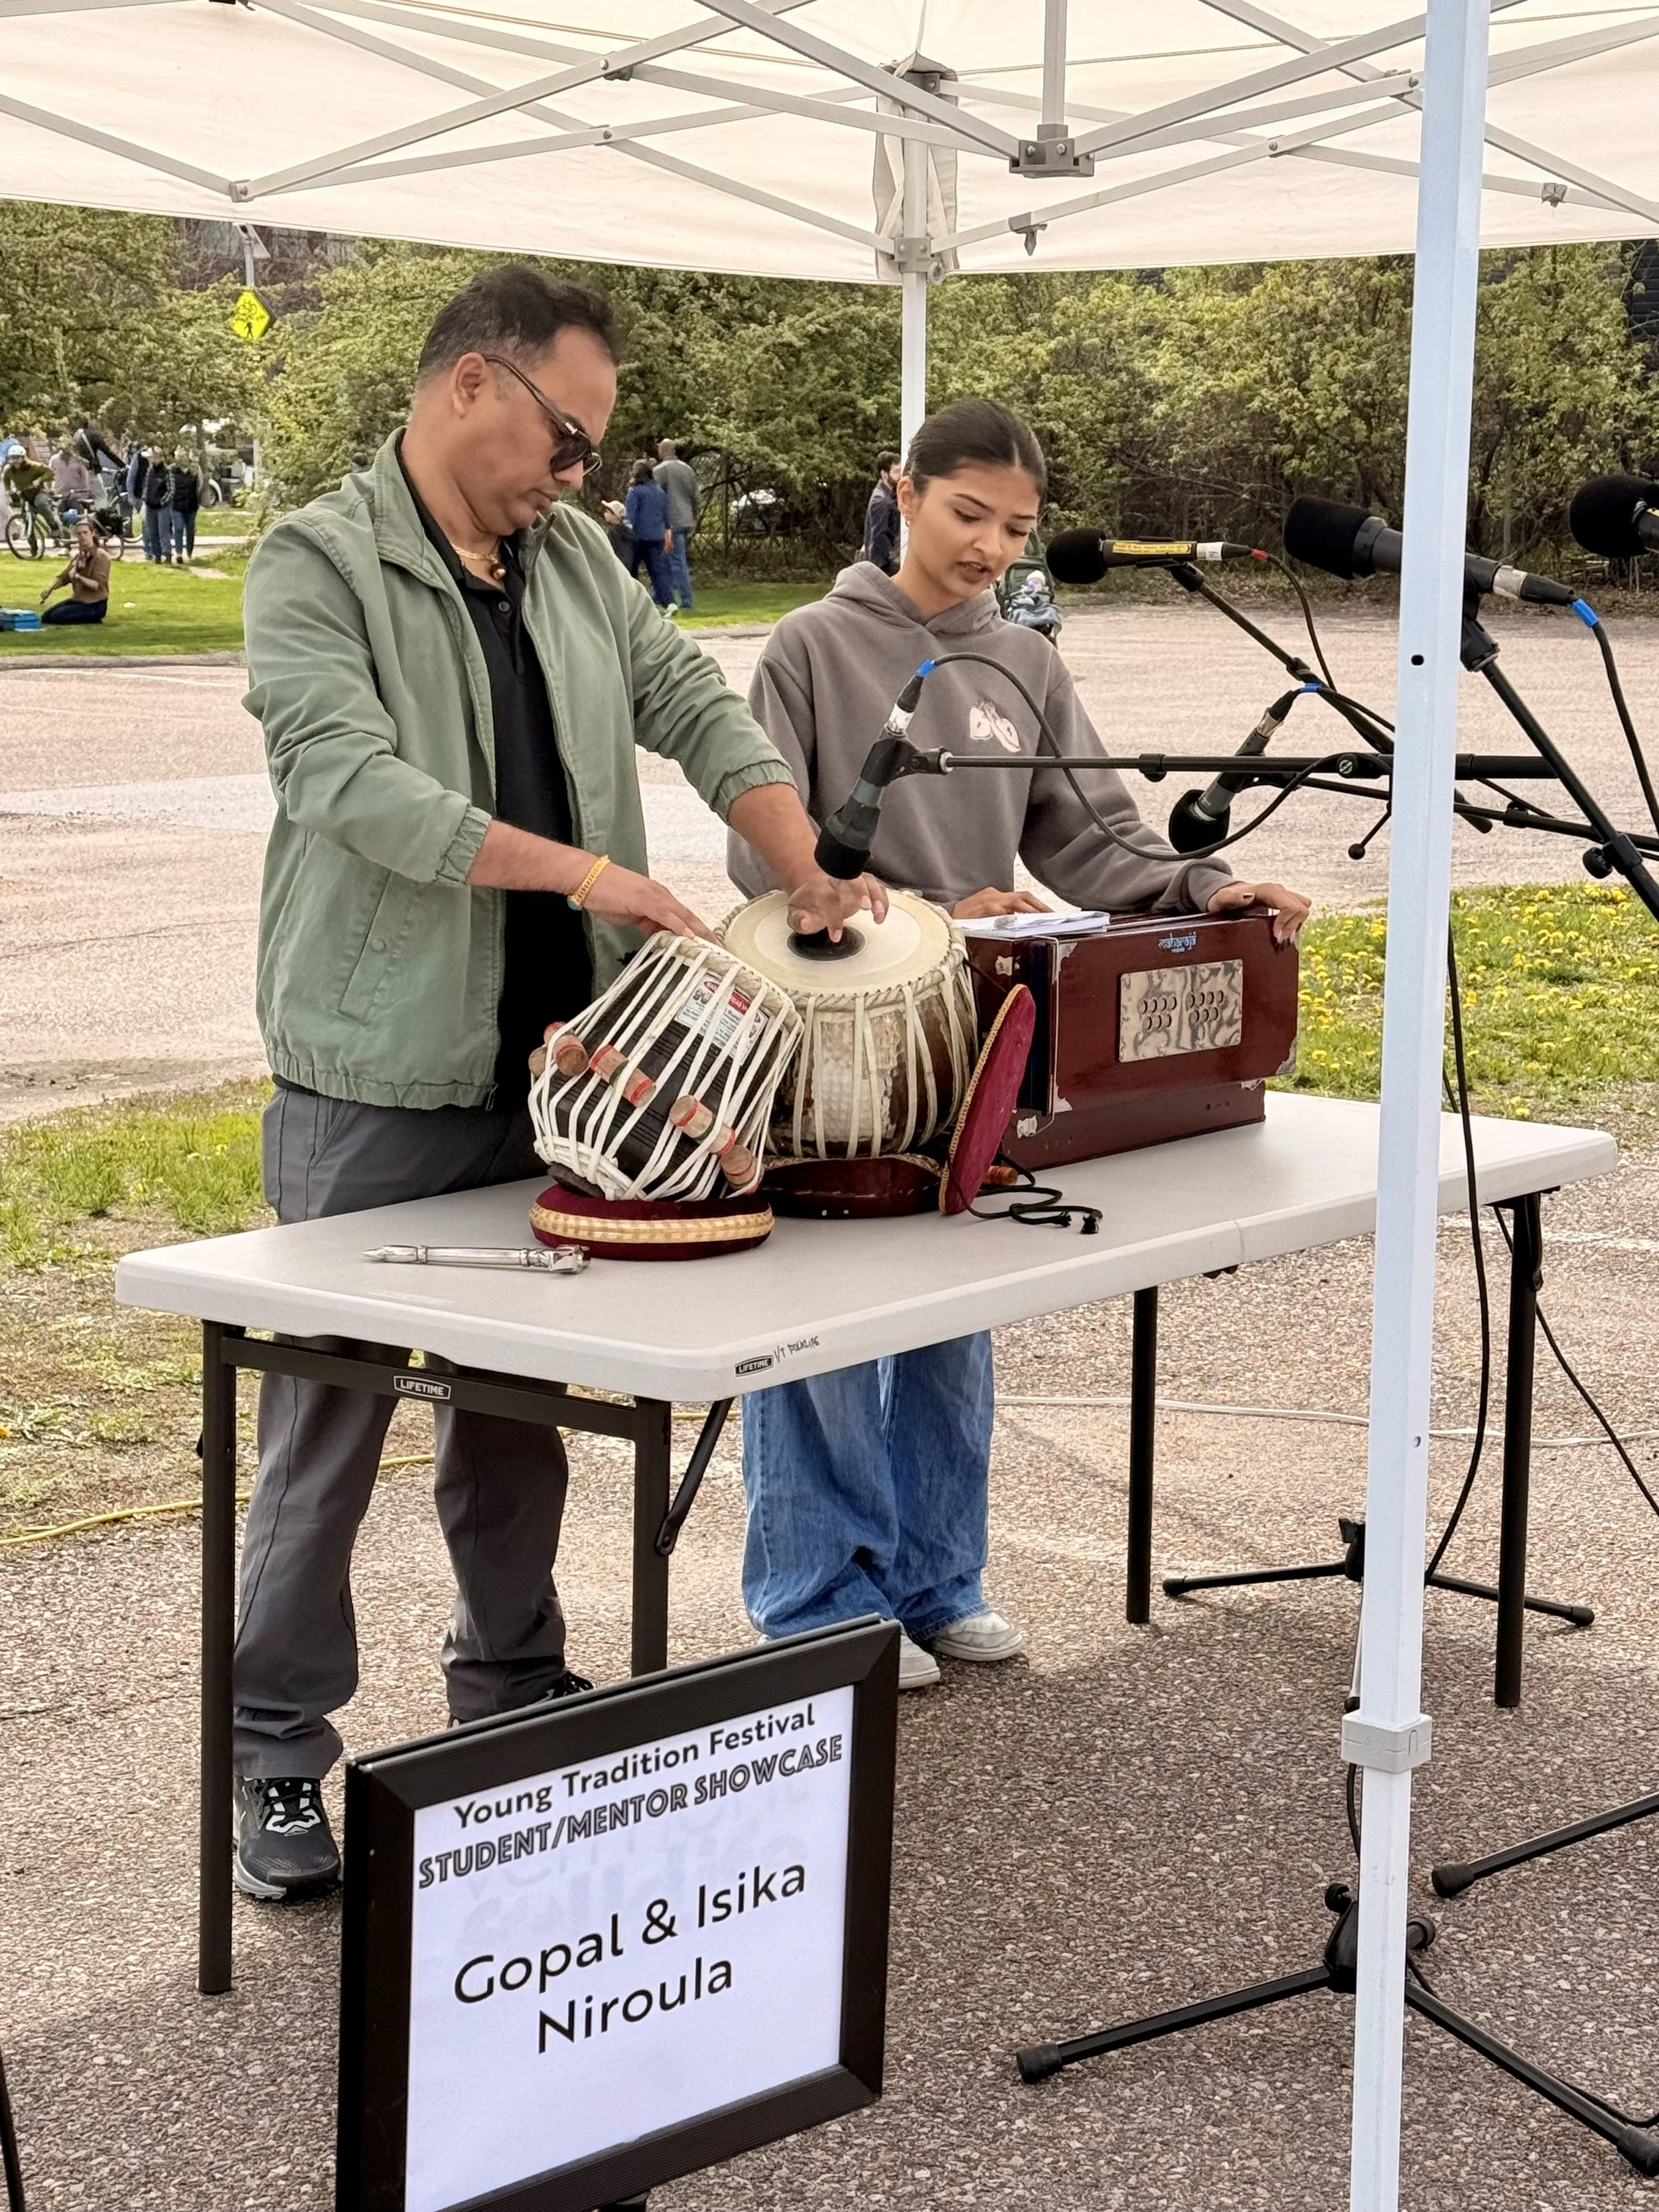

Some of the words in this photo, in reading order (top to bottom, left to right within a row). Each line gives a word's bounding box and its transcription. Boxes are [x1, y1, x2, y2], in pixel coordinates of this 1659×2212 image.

[400, 1378, 445, 1396] LIFETIME
[739, 1359, 769, 1373] LIFETIME
[419, 1783, 689, 1889] STUDENT/MENTOR
[694, 1734, 842, 1806] SHOWCASE
[453, 1785, 553, 1828] Young
[561, 1744, 699, 1798] Tradition
[710, 1702, 815, 1755] Festival
[454, 1913, 624, 2004] Gopal
[642, 1898, 678, 1945] &
[697, 1864, 805, 1928] Isika
[538, 1956, 732, 2054] Niroula
